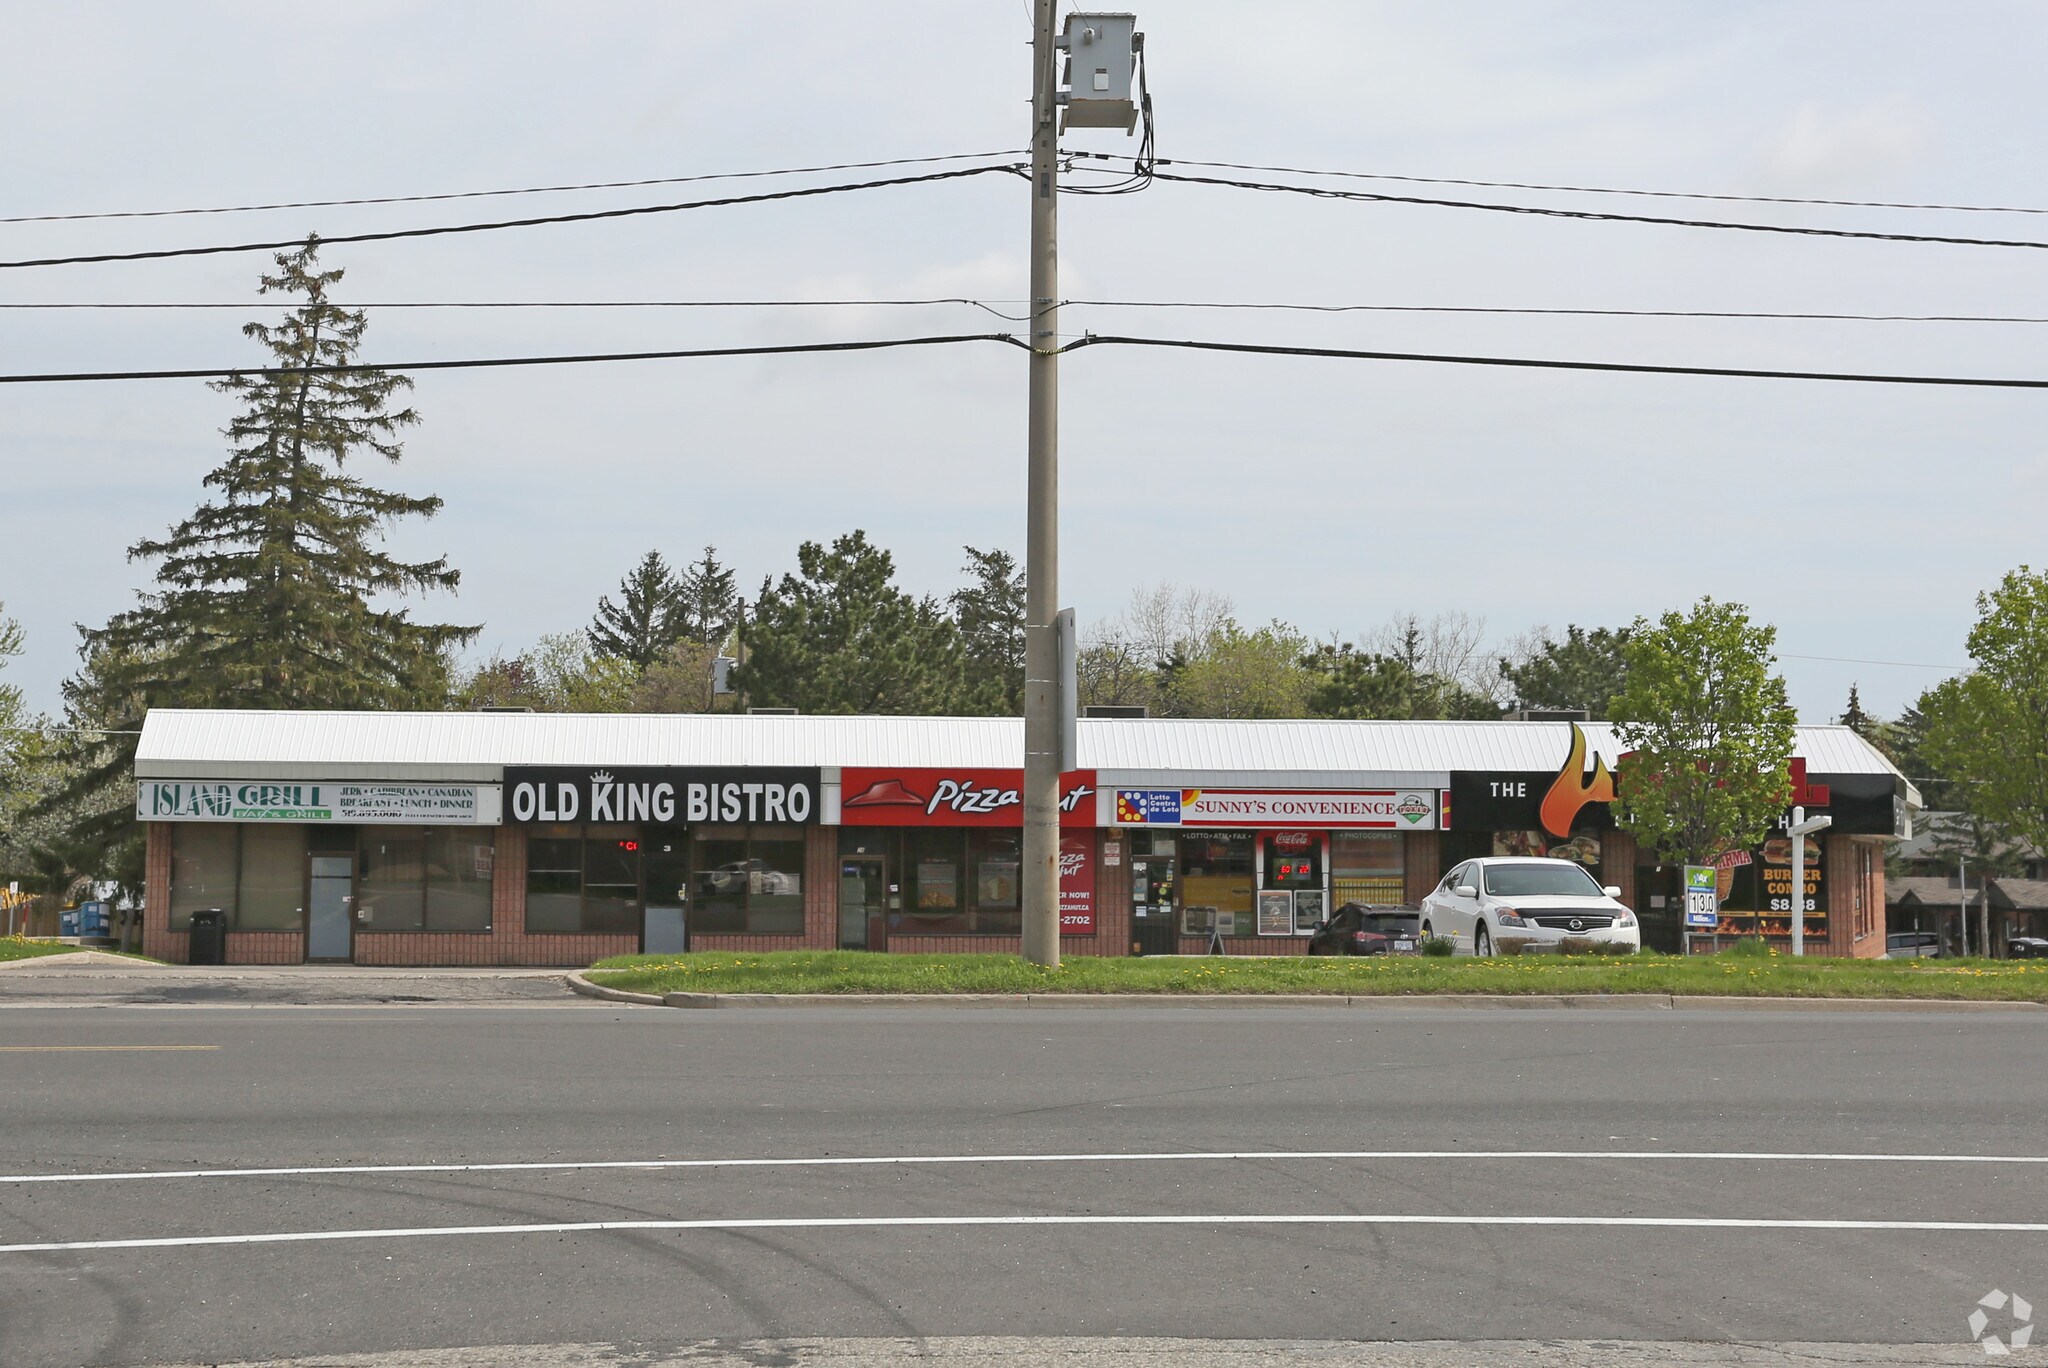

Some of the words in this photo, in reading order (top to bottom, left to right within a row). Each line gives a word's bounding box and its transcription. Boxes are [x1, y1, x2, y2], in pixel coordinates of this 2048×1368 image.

[340, 787, 361, 796] JERK
[428, 788, 473, 797] CANADIAN
[1490, 782, 1526, 797] THE
[153, 784, 232, 816] ISLAND
[237, 785, 328, 807] GRILL
[440, 799, 473, 808] DINNER
[512, 782, 579, 822] OLD
[591, 782, 675, 822] KING
[687, 782, 811, 822] BISTRO
[927, 780, 1020, 815] Pizza
[1195, 800, 1267, 814] SUNNY'S
[1272, 801, 1396, 815] CONVENIENCE
[1400, 805, 1429, 815] POKER
[236, 810, 262, 818] BAR
[286, 810, 330, 819] GRILL
[1763, 869, 1822, 881] BURER
